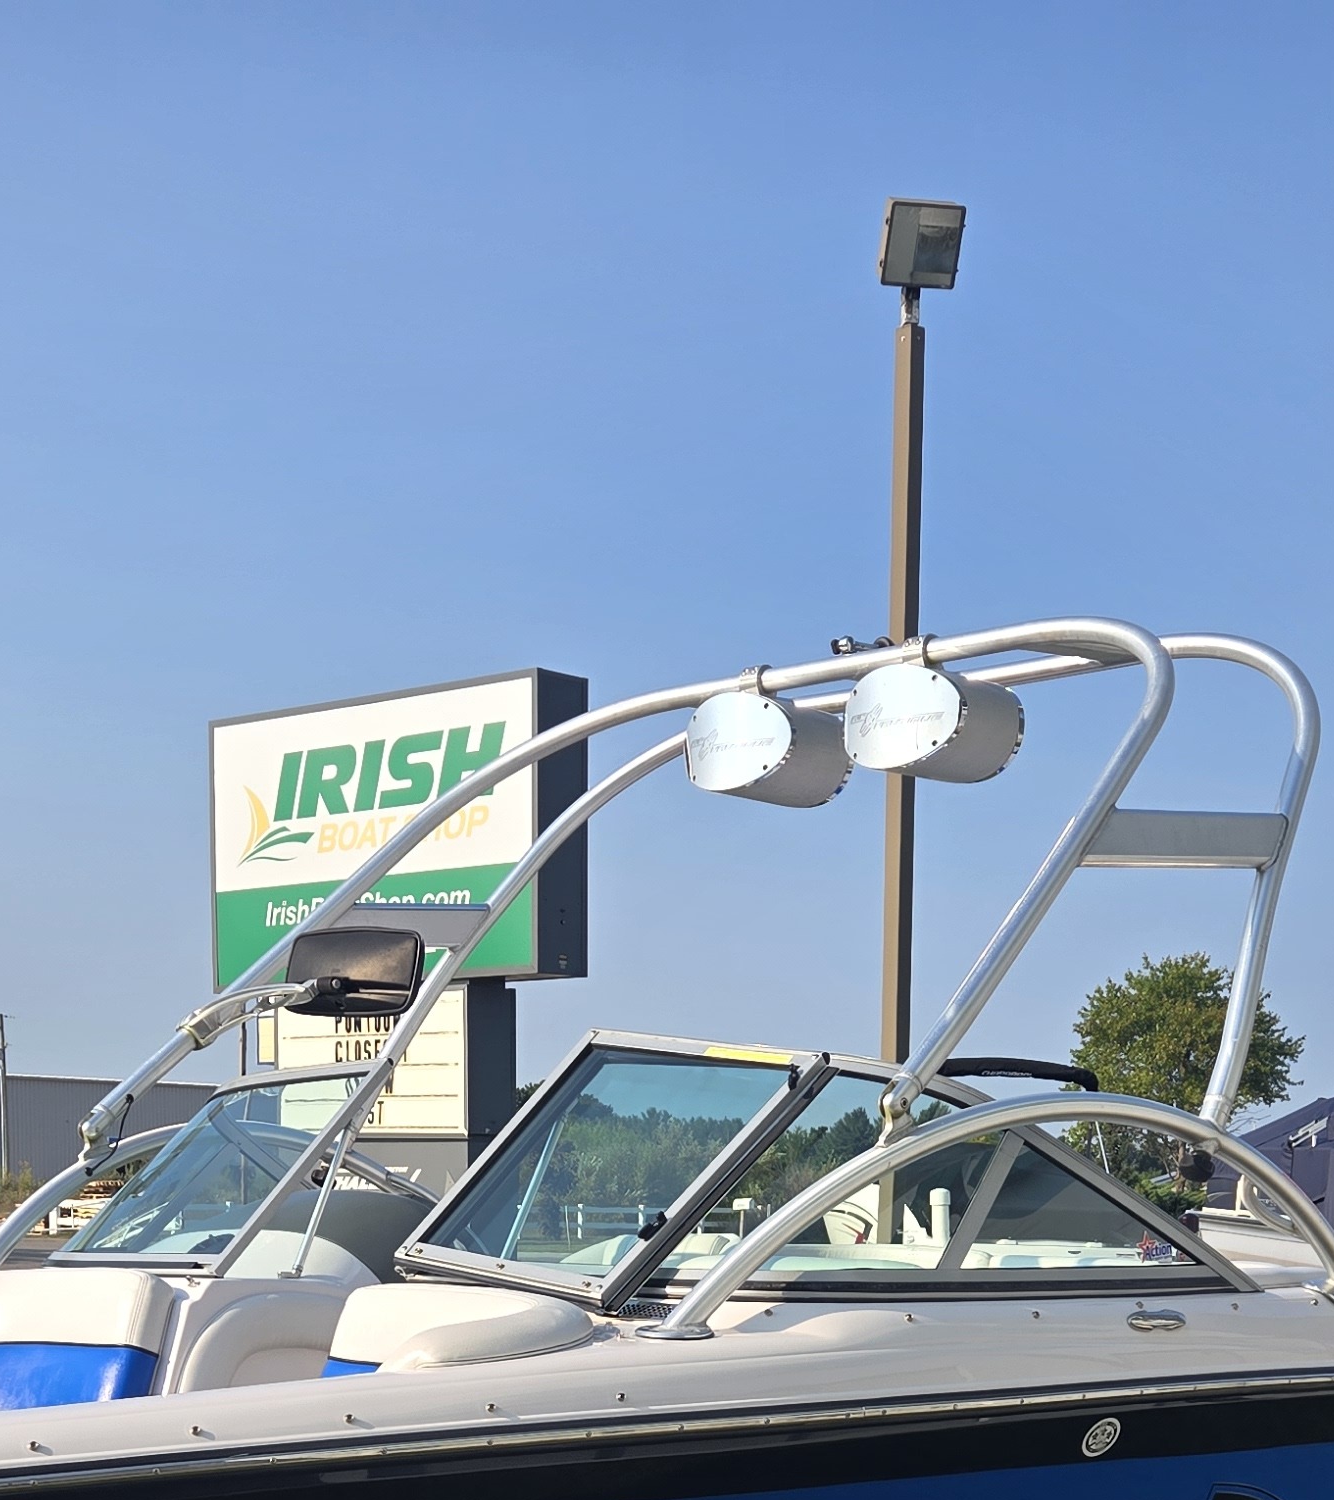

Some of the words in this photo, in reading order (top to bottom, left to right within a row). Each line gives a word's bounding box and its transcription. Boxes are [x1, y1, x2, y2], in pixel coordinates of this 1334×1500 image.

[273, 721, 506, 822] IRISH
[317, 815, 396, 853] BOAT
[402, 805, 489, 842] OP
